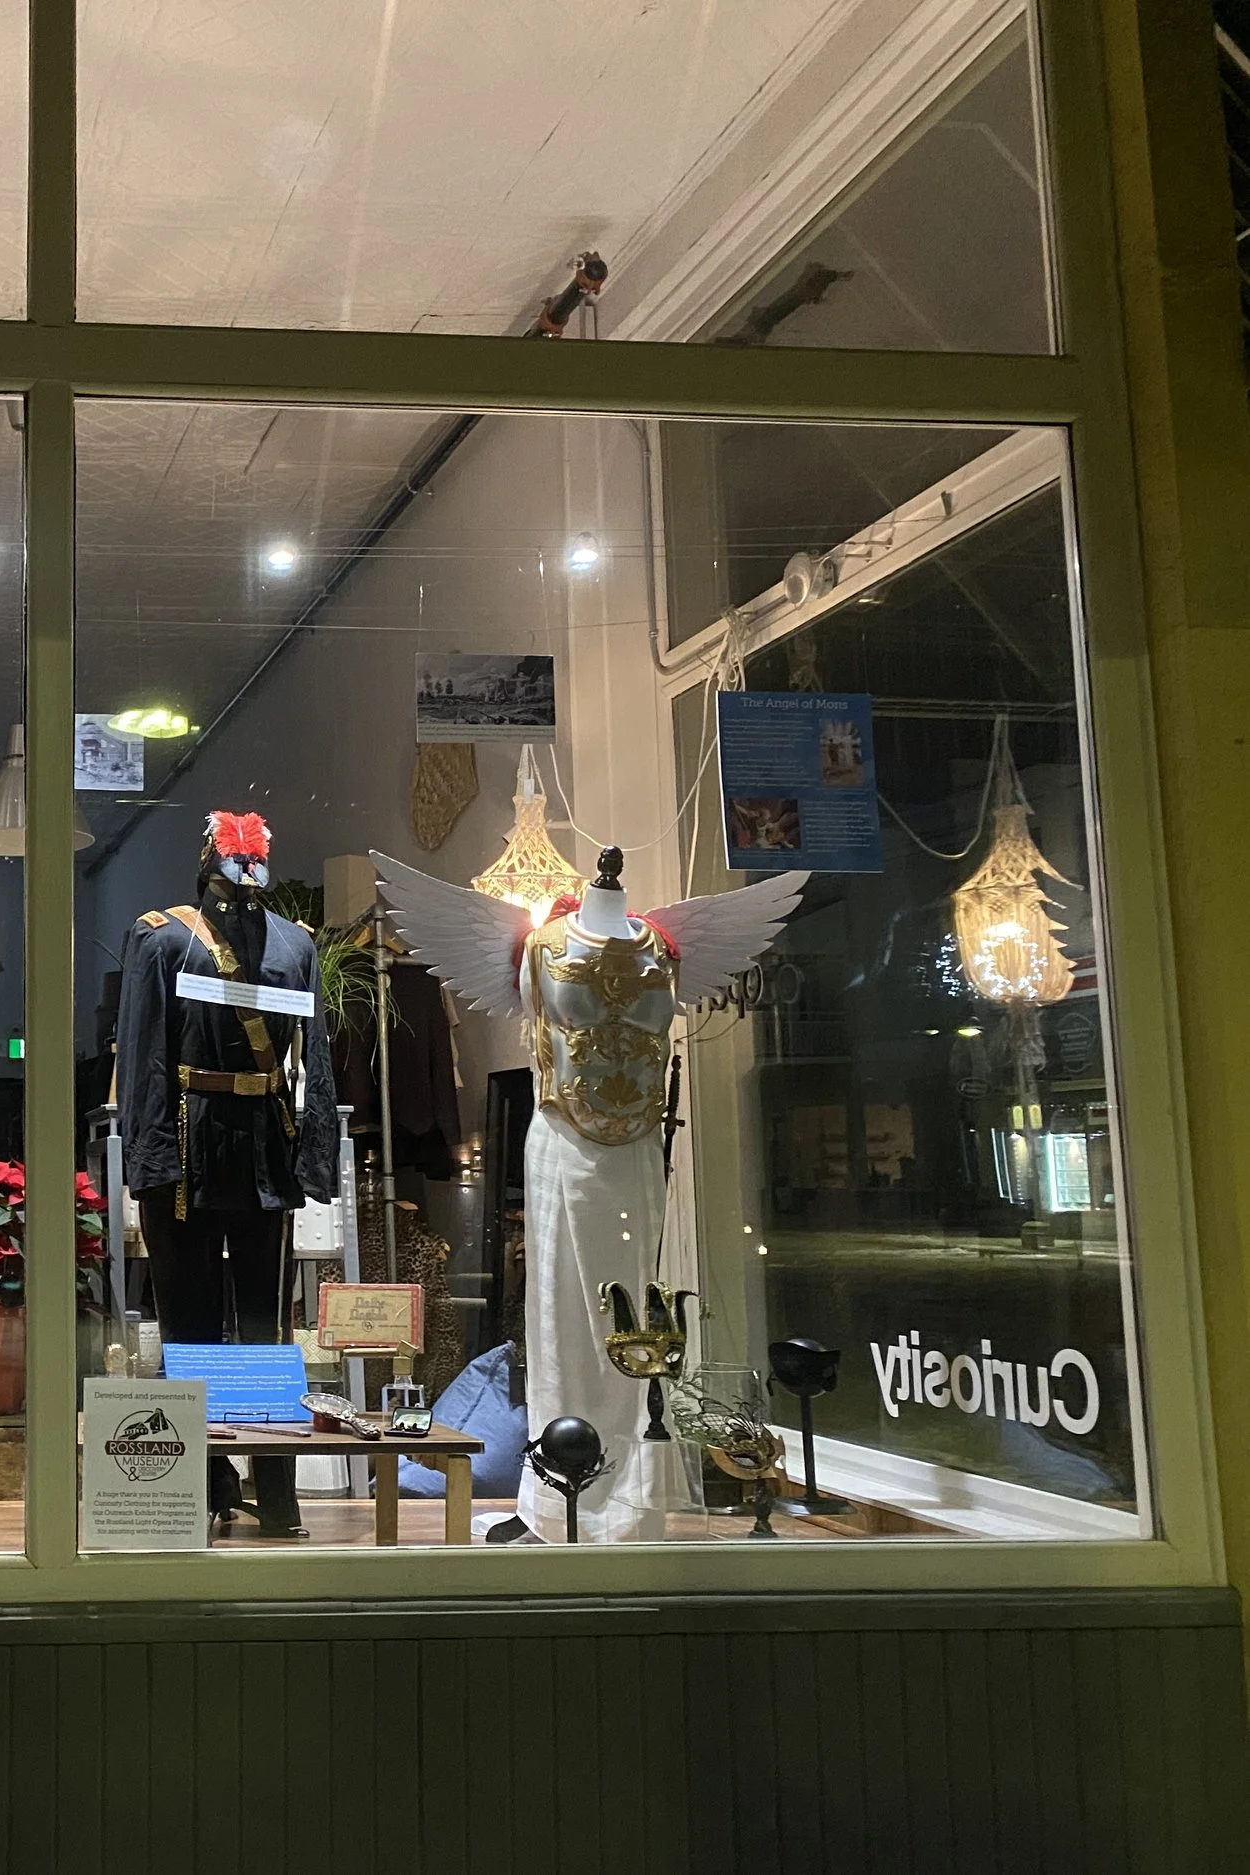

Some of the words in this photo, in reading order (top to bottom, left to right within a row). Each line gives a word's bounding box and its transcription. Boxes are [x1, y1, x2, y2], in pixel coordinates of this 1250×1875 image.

[766, 699, 799, 710] Angel
[94, 1391, 133, 1401] Developed
[150, 1393, 186, 1401] presented
[187, 1393, 197, 1402] by
[109, 1441, 182, 1454] ROSSLAND
[122, 1456, 170, 1466] MUSEUM
